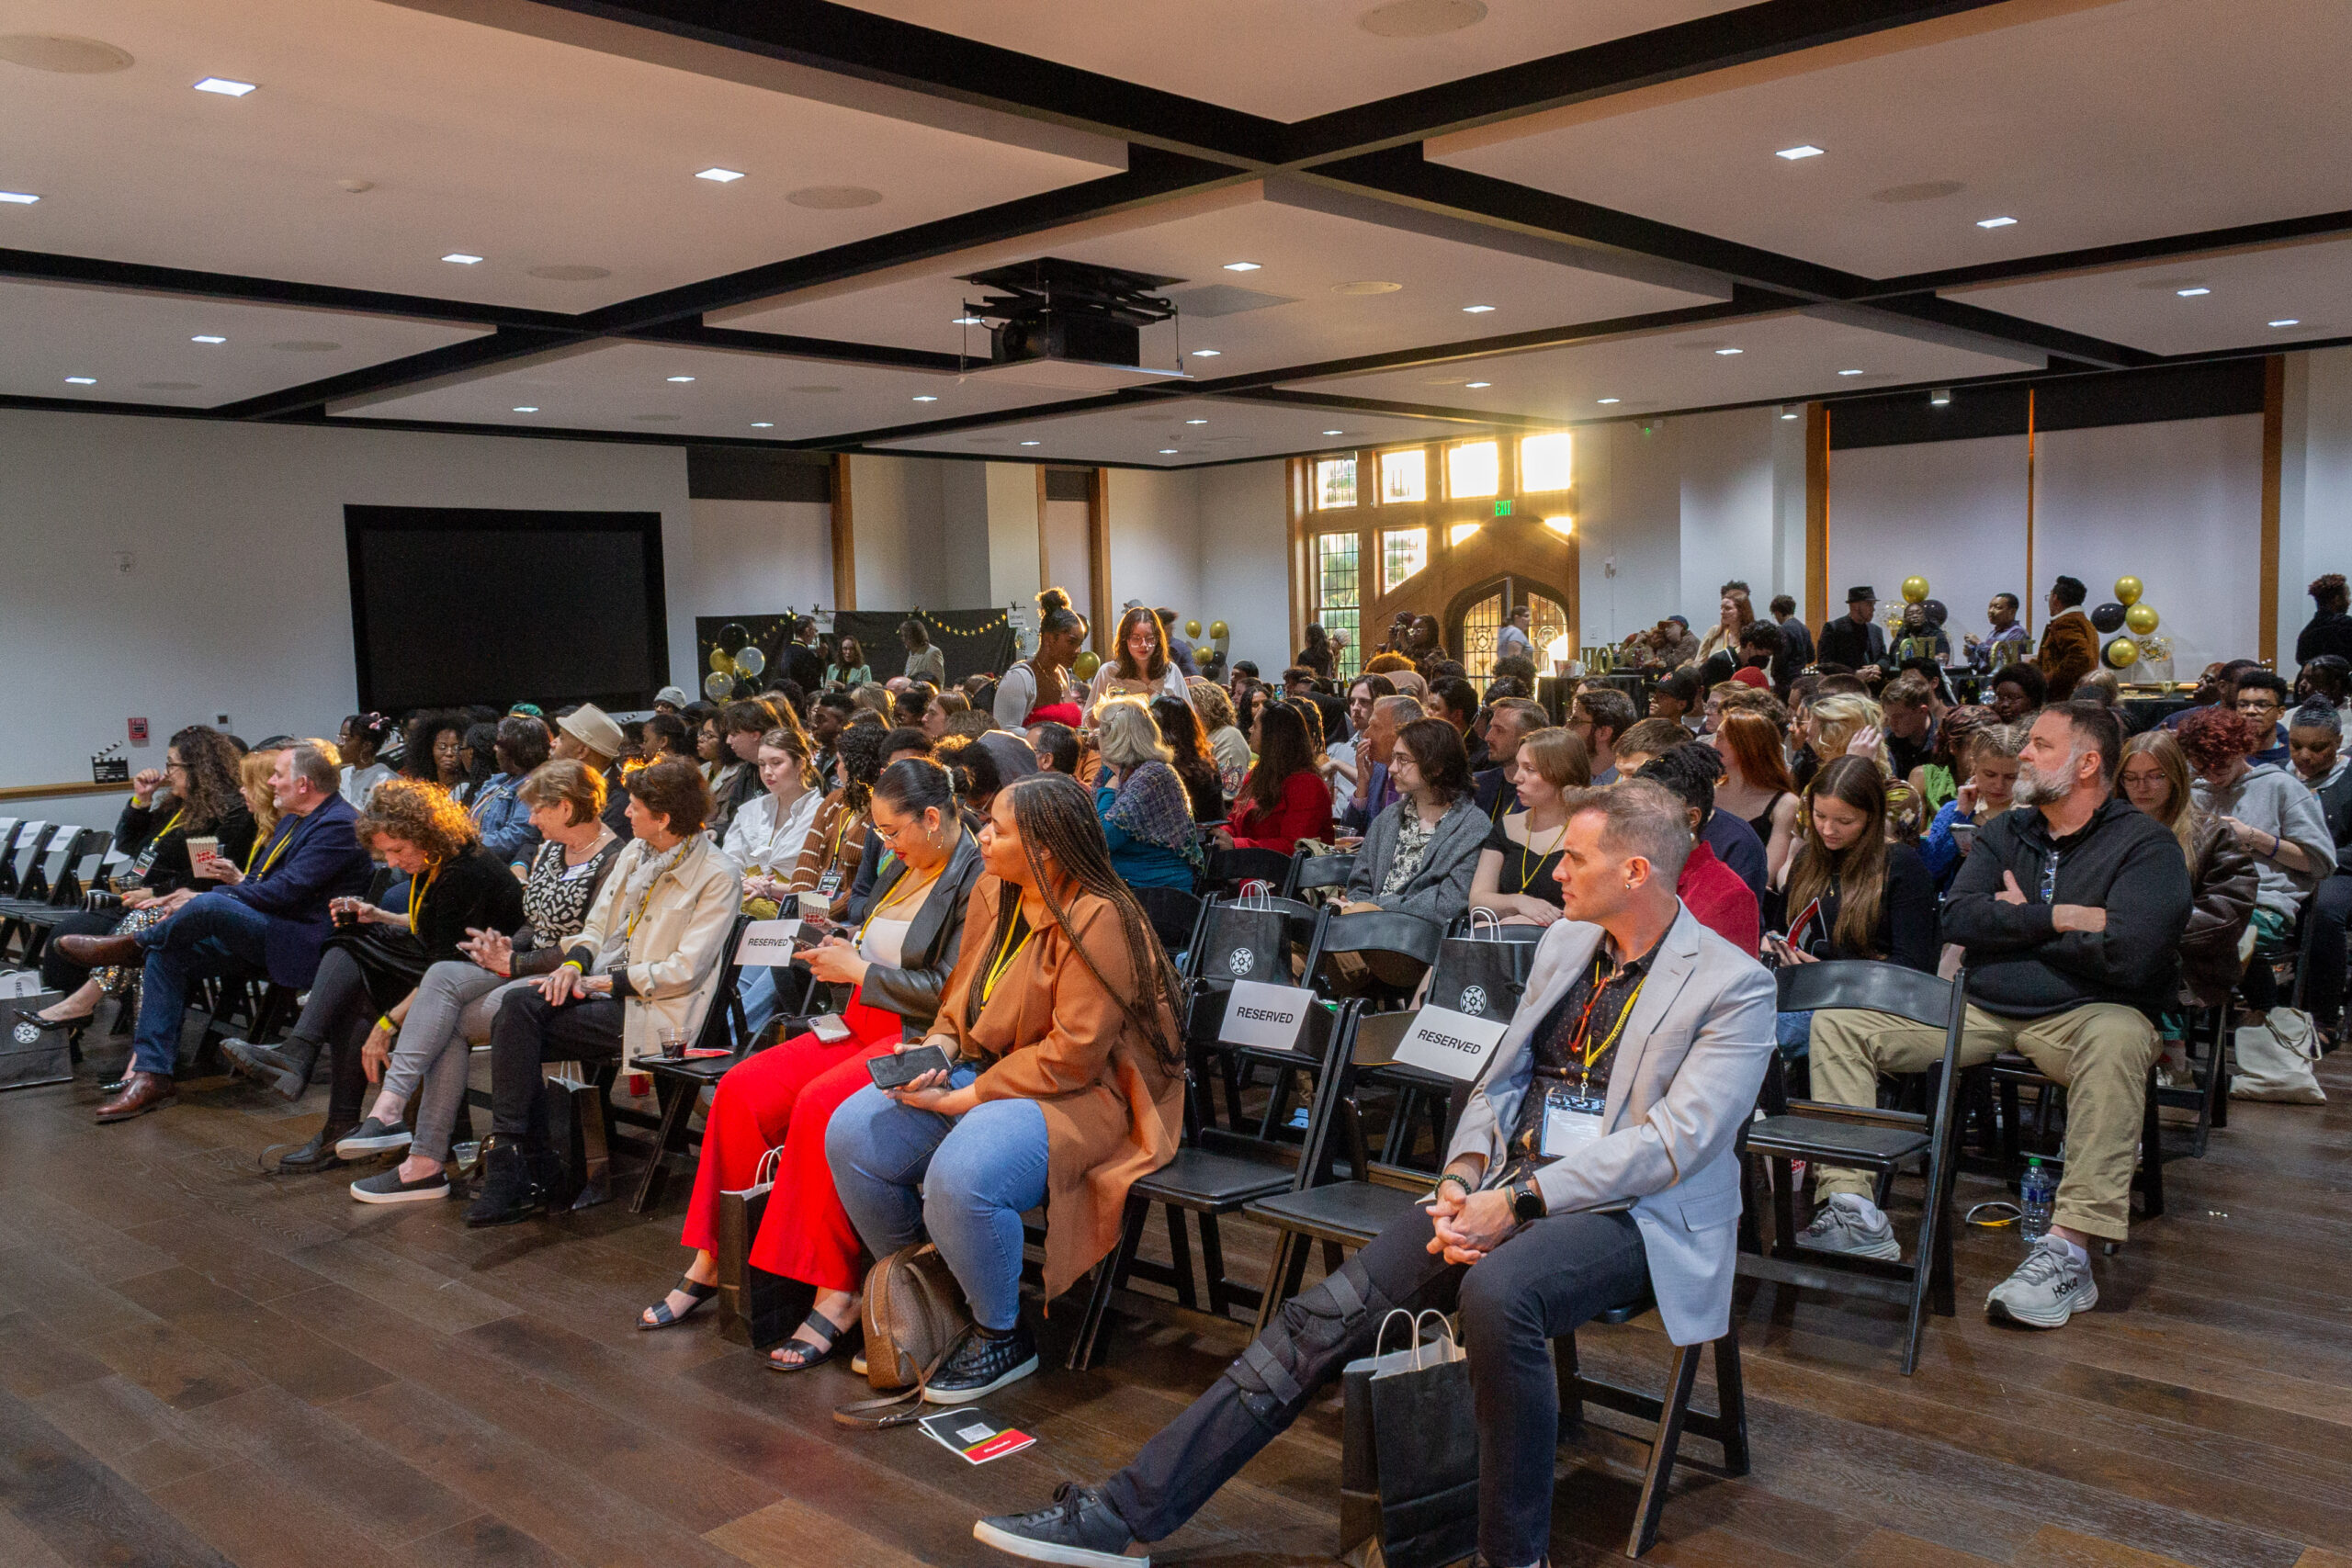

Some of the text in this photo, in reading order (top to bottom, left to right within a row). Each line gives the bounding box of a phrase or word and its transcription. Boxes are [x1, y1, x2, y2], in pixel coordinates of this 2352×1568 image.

[1495, 500, 1511, 516] EXIT
[748, 938, 788, 947] RESERVED
[1237, 1007, 1294, 1024] RESERVED
[1418, 1029, 1481, 1055] RESERVED
[2052, 1277, 2078, 1299] HOKA
